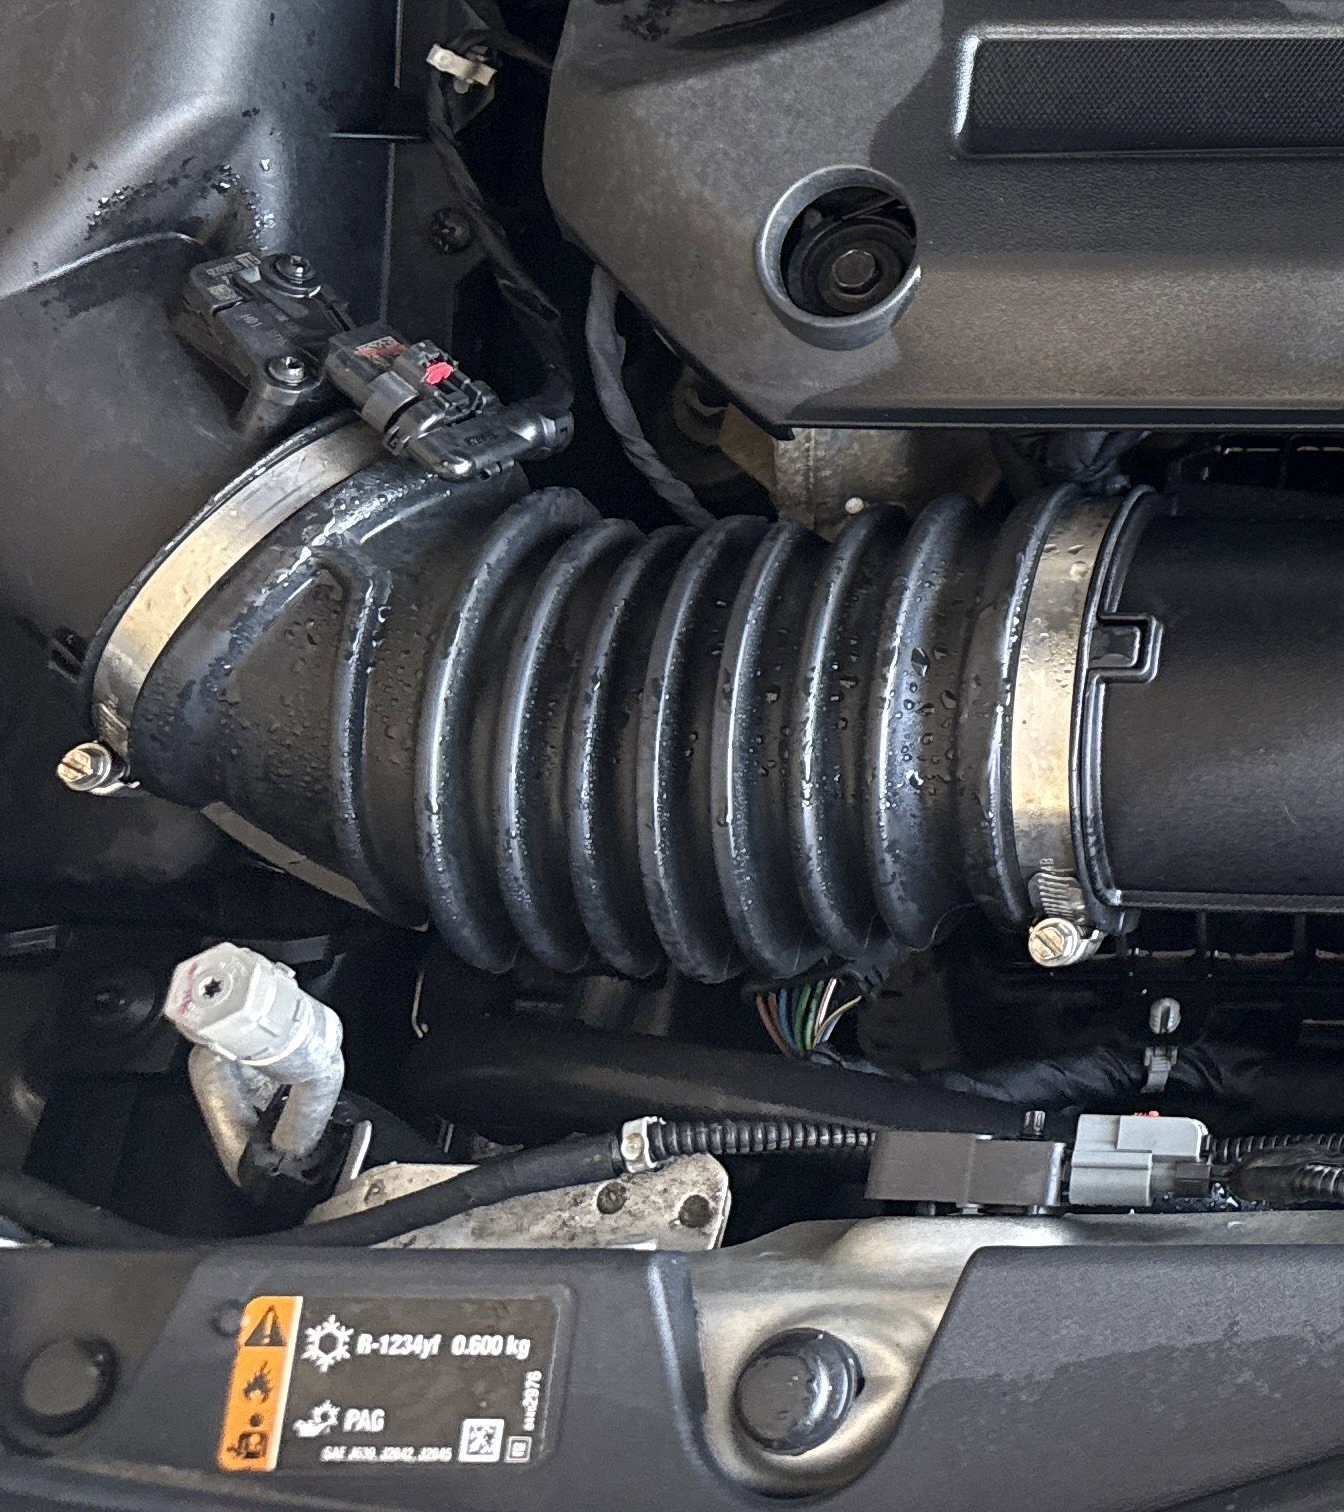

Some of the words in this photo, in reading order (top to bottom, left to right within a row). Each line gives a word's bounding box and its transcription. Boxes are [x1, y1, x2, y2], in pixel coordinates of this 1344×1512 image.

[451, 1335, 504, 1356] 0.600
[505, 1335, 531, 1360] kg
[343, 1407, 385, 1432] PAG
